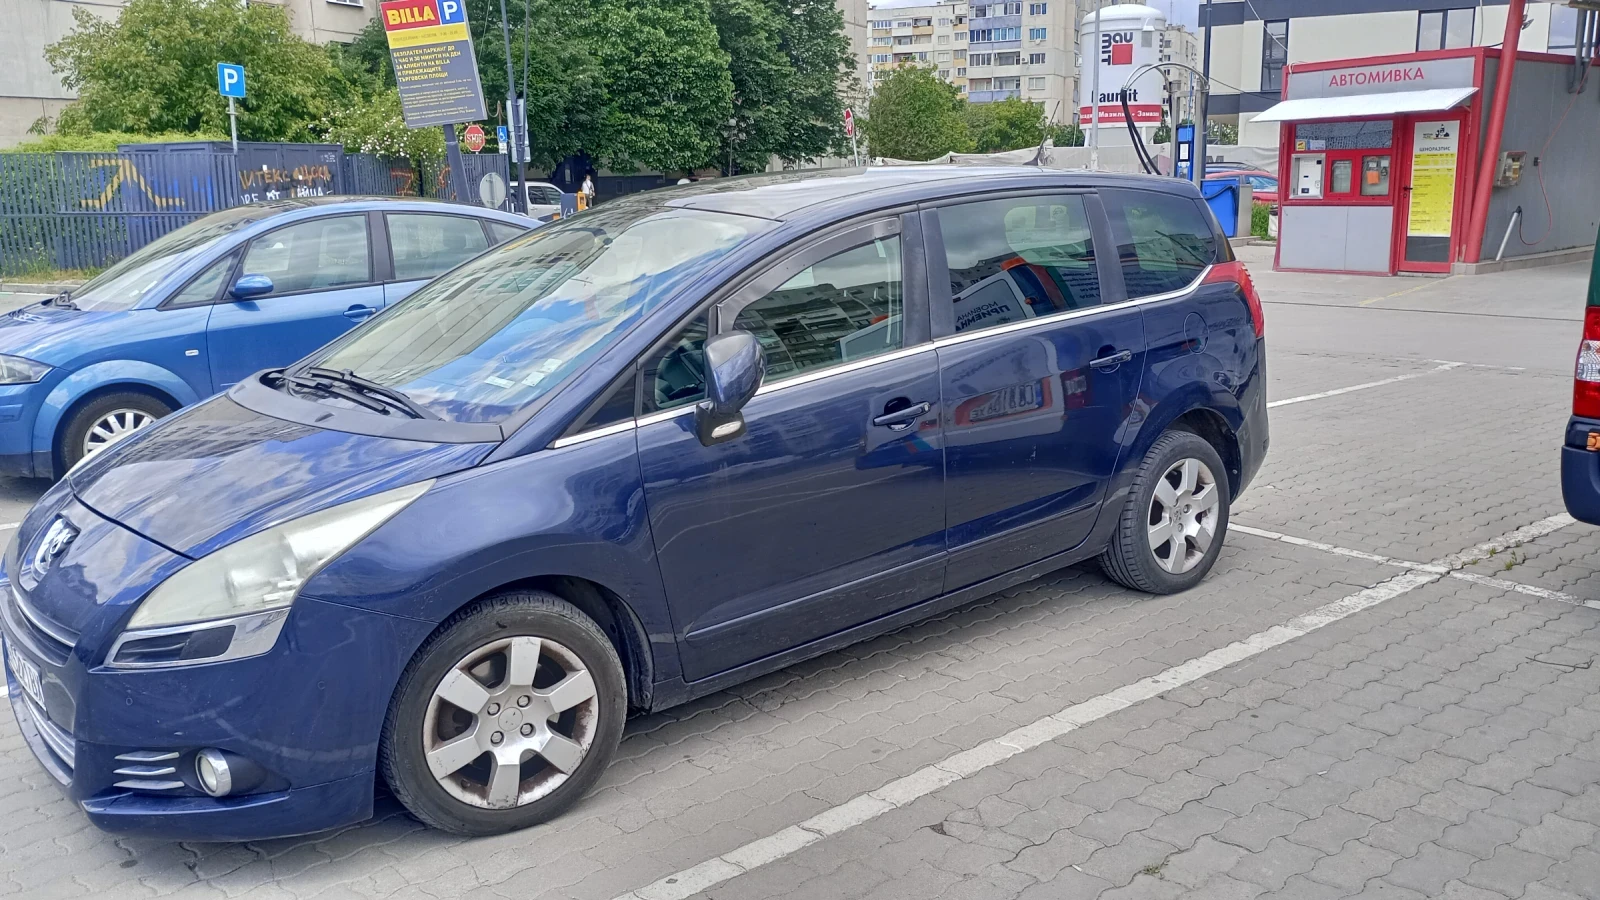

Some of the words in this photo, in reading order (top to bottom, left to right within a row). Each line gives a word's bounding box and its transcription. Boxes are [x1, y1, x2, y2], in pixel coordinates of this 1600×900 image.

[386, 5, 435, 25] BILLA
[442, 1, 458, 20] P
[393, 49, 422, 57] БЕЗПЛАТЕН
[423, 46, 446, 54] ПАРКИНГ
[420, 53, 442, 61] МИНУТИ
[402, 67, 442, 76] ПРИЛЕЖАЩИТЕ
[1329, 67, 1424, 87] АВТОМИВКА
[223, 68, 238, 91] P
[398, 74, 428, 82] ТЪРГОВСКИ
[1091, 89, 1138, 103] auit
